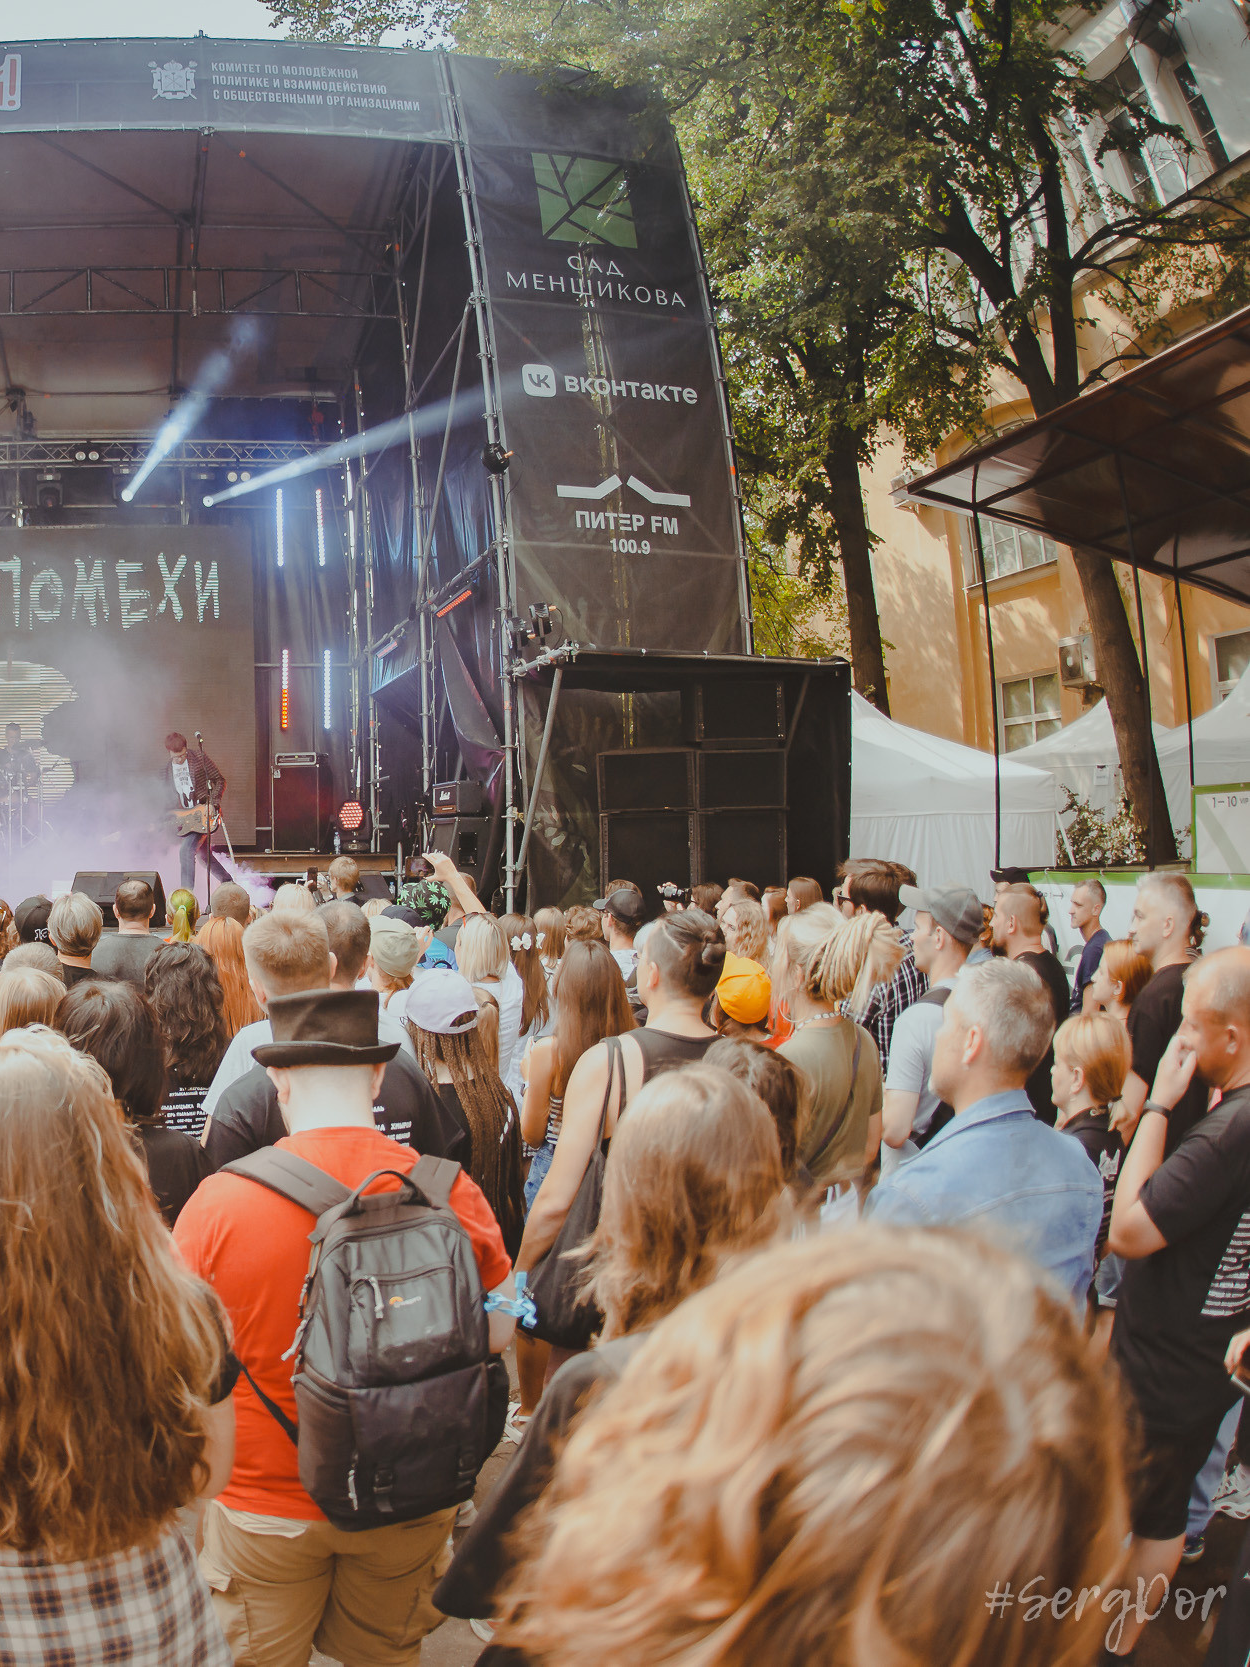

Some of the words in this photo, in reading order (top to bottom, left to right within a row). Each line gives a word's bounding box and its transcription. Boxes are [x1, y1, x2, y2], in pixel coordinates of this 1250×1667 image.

[211, 62, 261, 74] КОМИТЕТ
[264, 65, 279, 75] ПО
[282, 64, 359, 79] МОЛОДЁЖНОЙ
[212, 75, 270, 88] ПОЛИТИКЕ
[273, 79, 281, 88] И
[283, 78, 387, 95] ВЗАИМОДЕЙСТВИЮ
[213, 90, 220, 100] С
[223, 90, 324, 105] ОБЩЕСТВЕННЫМИ
[326, 95, 421, 111] ОРГАНИЗАЦИЯМИ
[567, 255, 624, 278] САД
[506, 271, 686, 307] МЕНШИКОВА
[575, 510, 645, 532] ПИТЕР
[650, 515, 679, 535] FM
[610, 538, 651, 555] 100.9
